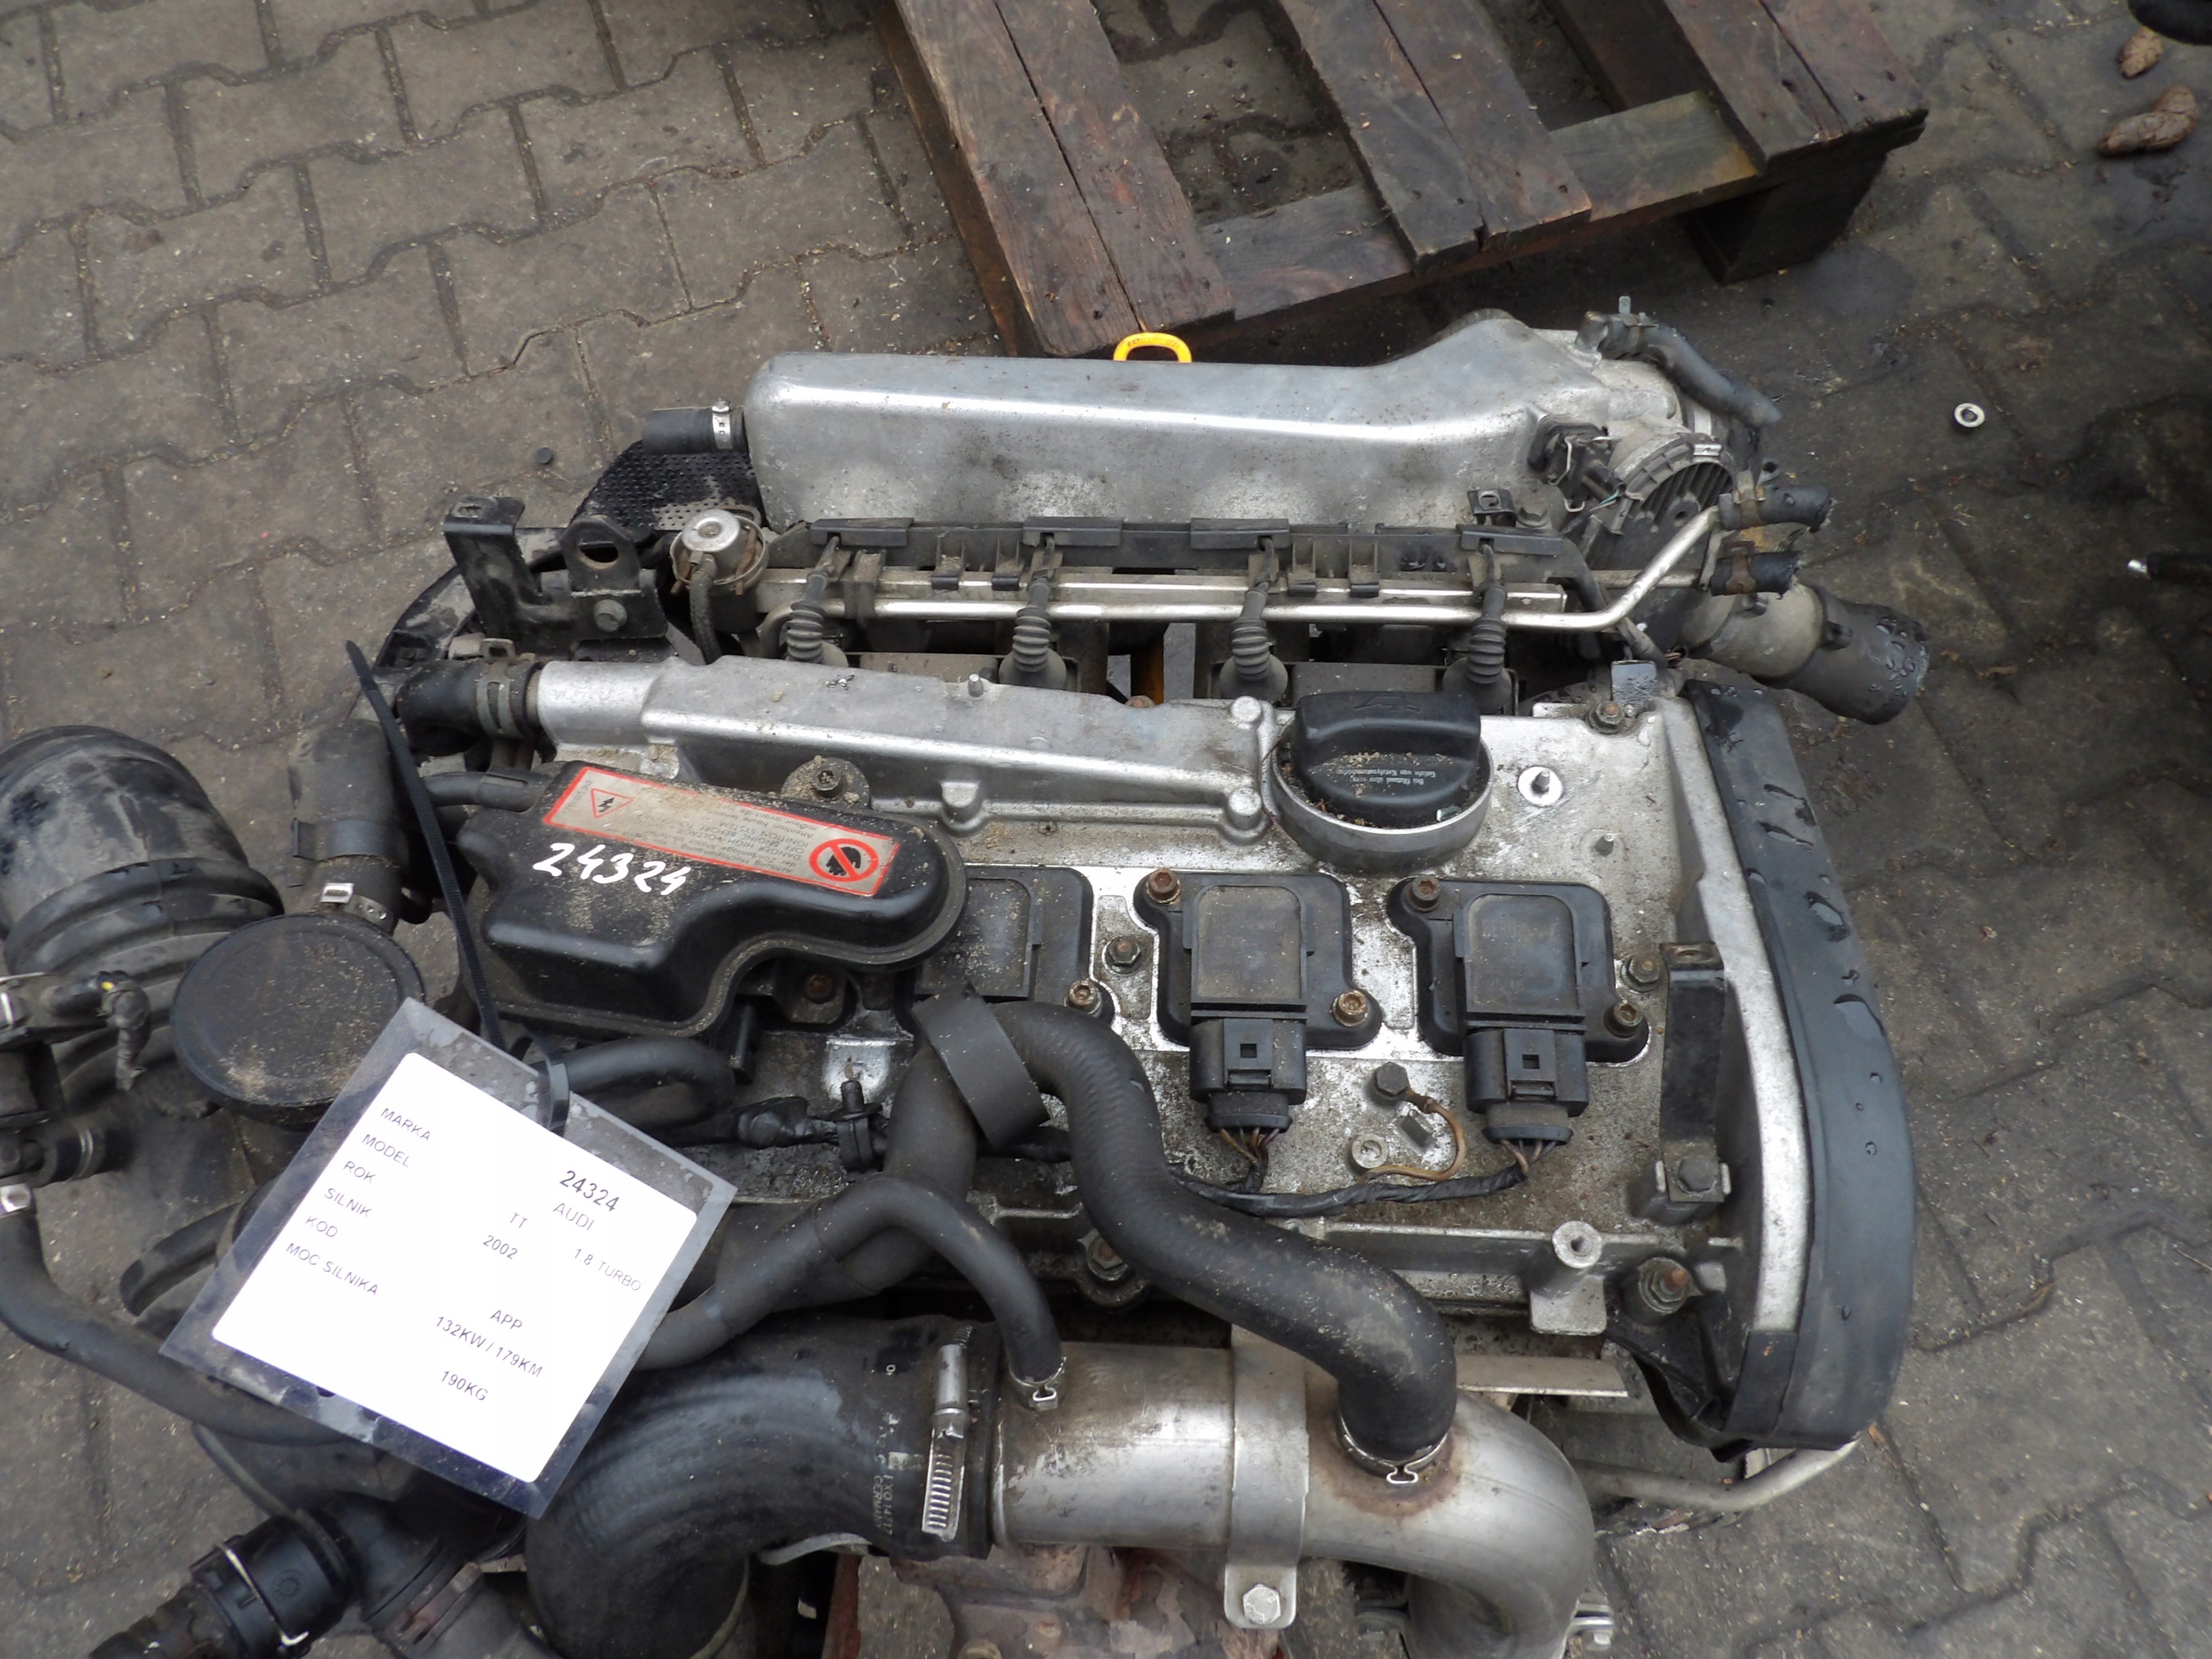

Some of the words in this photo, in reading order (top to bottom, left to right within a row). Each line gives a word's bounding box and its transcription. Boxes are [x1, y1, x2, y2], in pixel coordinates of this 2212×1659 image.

[699, 825, 736, 837] BEFORE
[719, 821, 757, 835] SYSTEM
[742, 817, 768, 827] haute
[772, 825, 814, 839] Attention
[727, 838, 754, 849] HIGH
[760, 830, 810, 848] IGNITION
[783, 844, 804, 854] OFF
[759, 846, 802, 861] DANGER
[380, 1107, 431, 1141] MARKA
[361, 1133, 410, 1168] MODEL
[342, 1160, 377, 1184] ROK
[324, 1187, 372, 1217] SILNIK
[558, 1170, 620, 1212] 24324
[304, 1215, 339, 1238] KOD
[509, 1211, 529, 1229] TT
[552, 1202, 595, 1231] AUDI
[482, 1234, 518, 1260] 2002
[285, 1242, 321, 1266] MOC
[322, 1261, 378, 1296] SILNIKA
[574, 1248, 594, 1266] 1.8
[598, 1260, 641, 1291] TURBO
[489, 1309, 523, 1330] APP
[435, 1316, 487, 1349] 132KW
[495, 1346, 543, 1378] 179KM
[441, 1370, 488, 1402] 190KG
